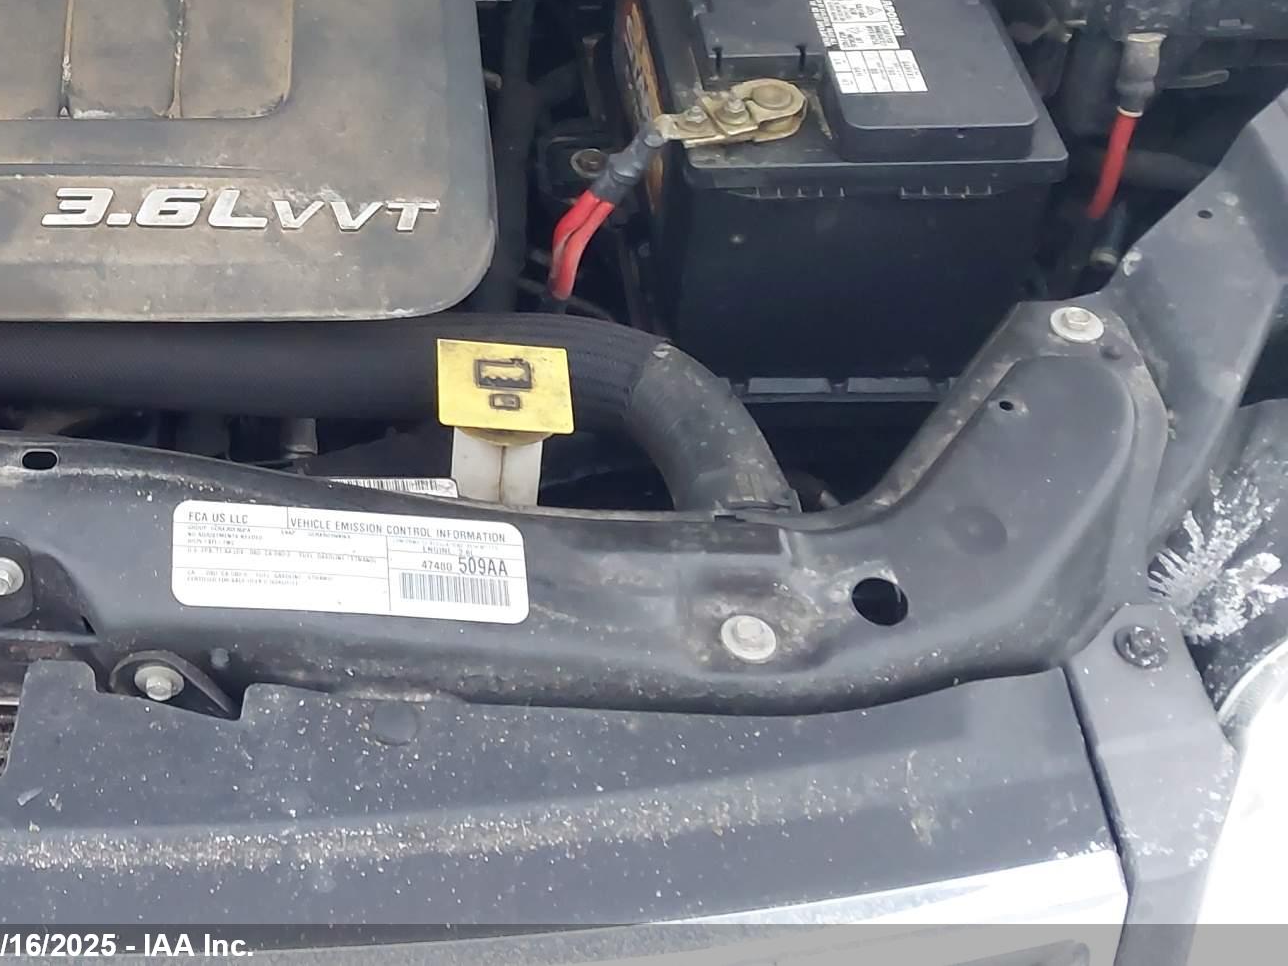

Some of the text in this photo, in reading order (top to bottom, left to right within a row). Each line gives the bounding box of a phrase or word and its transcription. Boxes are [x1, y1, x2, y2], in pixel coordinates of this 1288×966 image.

[188, 511, 249, 524] FCA US LLC
[290, 518, 332, 532] VEHICLE
[335, 520, 383, 534] EMISSION
[386, 523, 432, 538] CONTROL
[436, 527, 506, 543] INFORMATION
[458, 556, 509, 576] 509AA
